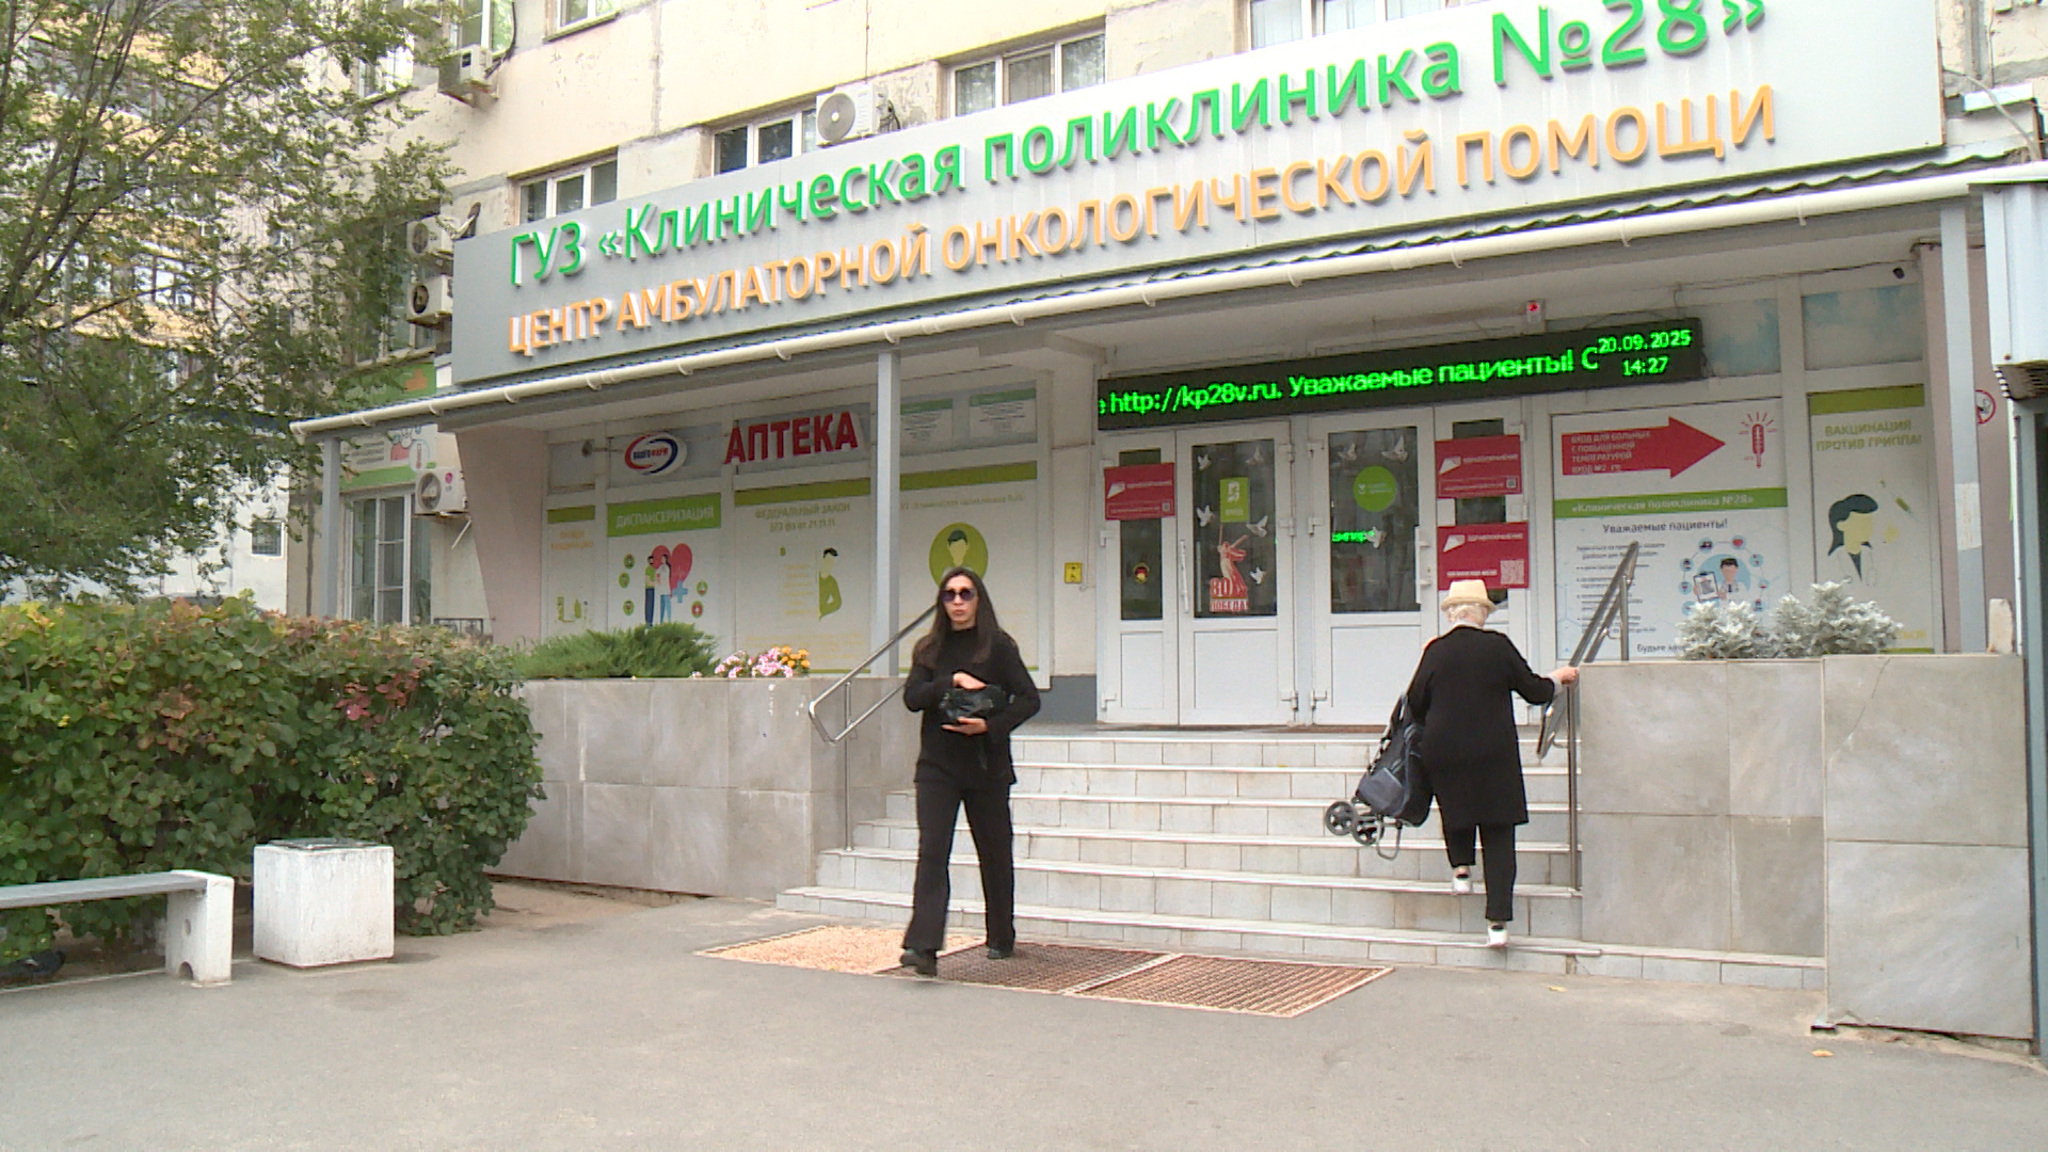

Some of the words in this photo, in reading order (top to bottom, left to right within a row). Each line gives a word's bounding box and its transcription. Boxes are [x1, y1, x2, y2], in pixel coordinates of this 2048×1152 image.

[510, 222, 585, 286] ГУЗ
[600, 144, 964, 258] «Клиническая
[984, 42, 1462, 182] поликлиника
[509, 298, 608, 355] ЦЕНТР
[617, 223, 931, 331] АМБУЛАТОРНОЙ
[941, 129, 1436, 272] ОНКОЛОГИЧЕСКОЙ
[1456, 84, 1775, 187] ПОМОЩИ
[1598, 329, 1692, 354] 20.09.2025
[1622, 355, 1669, 376] 14:27
[1110, 382, 1283, 415] http://kp28v.ru.
[1288, 367, 1434, 397] Уважаемые
[1438, 349, 1574, 383] пациенты!
[1581, 346, 1599, 370] С
[725, 411, 858, 464] АПТЕКА
[1824, 419, 1912, 436] ВАКЦИНАЦИЯ
[1816, 438, 1864, 451] ПРОТИВ
[615, 505, 714, 529] ДИСПАНСЕРИЗАЦИЯ
[1603, 523, 1667, 534] Уважаемые
[1669, 518, 1728, 531] пациенты!
